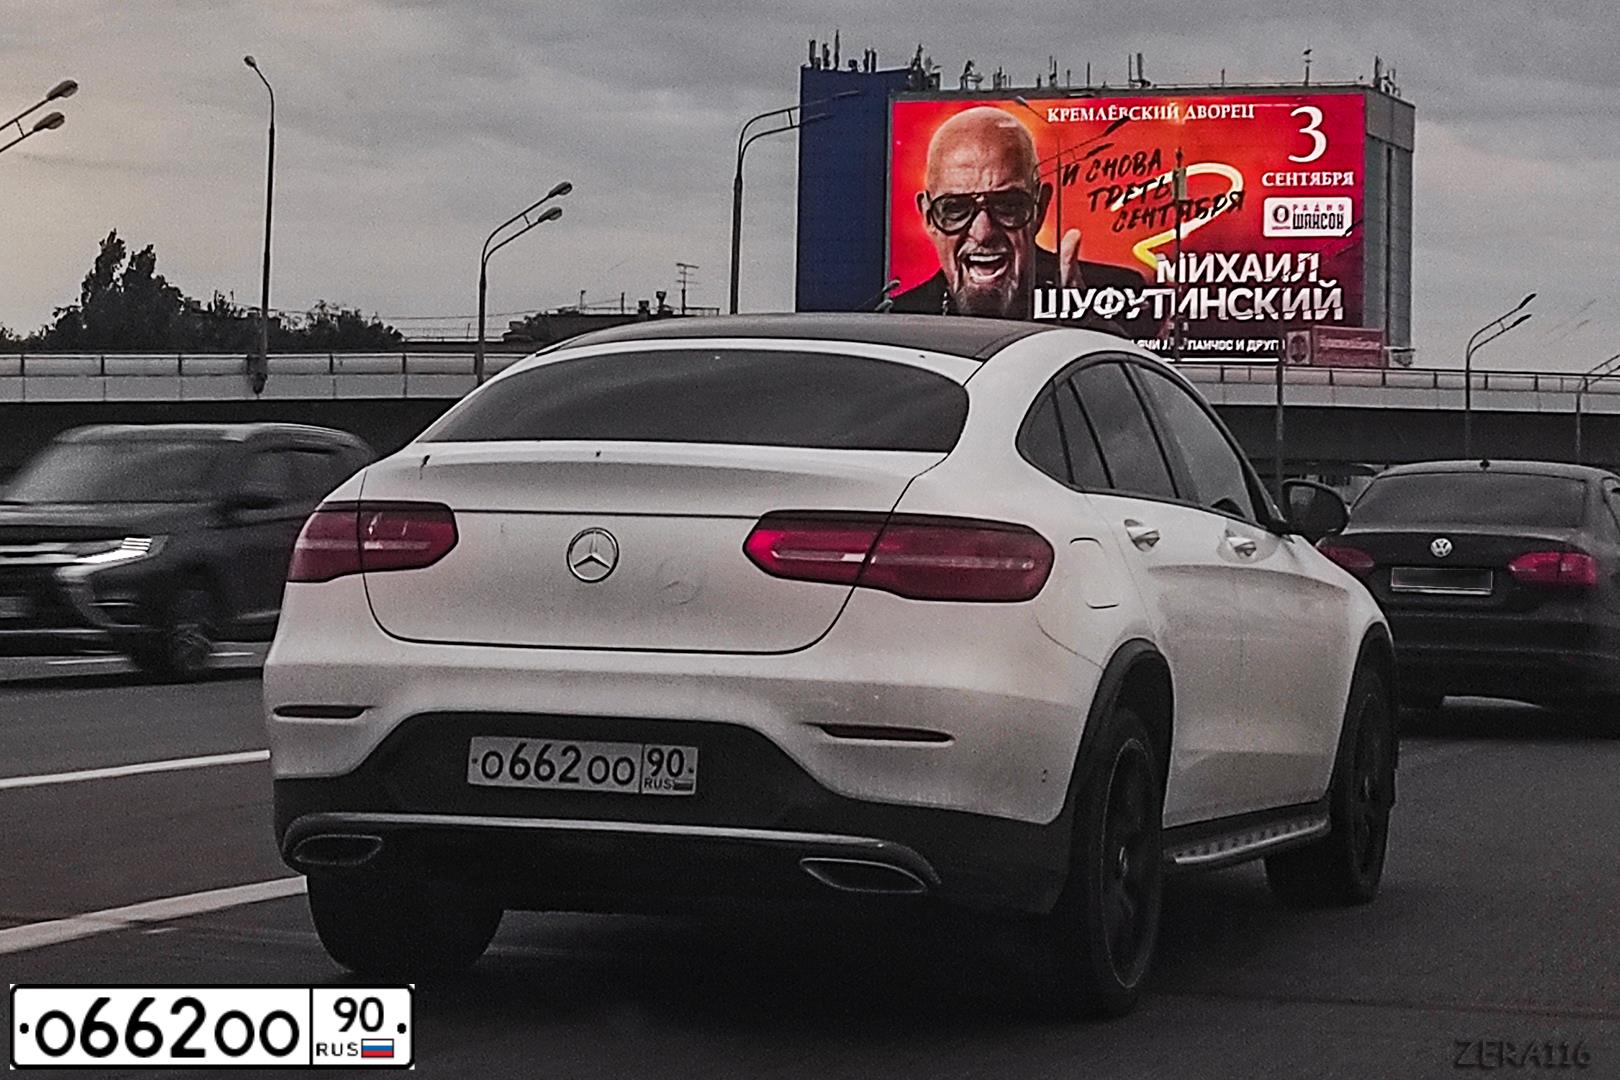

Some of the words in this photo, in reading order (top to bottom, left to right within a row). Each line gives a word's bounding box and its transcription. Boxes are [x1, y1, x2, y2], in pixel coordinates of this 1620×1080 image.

[1183, 104, 1255, 122] ДВОРЕЦ
[1288, 105, 1327, 163] 3
[1062, 163, 1080, 187] И
[1085, 148, 1162, 182] СНОВА
[1261, 171, 1355, 187] СЕНТЯБРЯ
[1087, 170, 1186, 212] ТРЕТЬ
[1112, 190, 1246, 233] СЕНТЯБРЯ
[1156, 252, 1320, 284] МИХАИЛ
[1033, 279, 1344, 321] ШУФУТИНСКИЙ
[646, 748, 685, 778] 90
[643, 778, 673, 791] RUS
